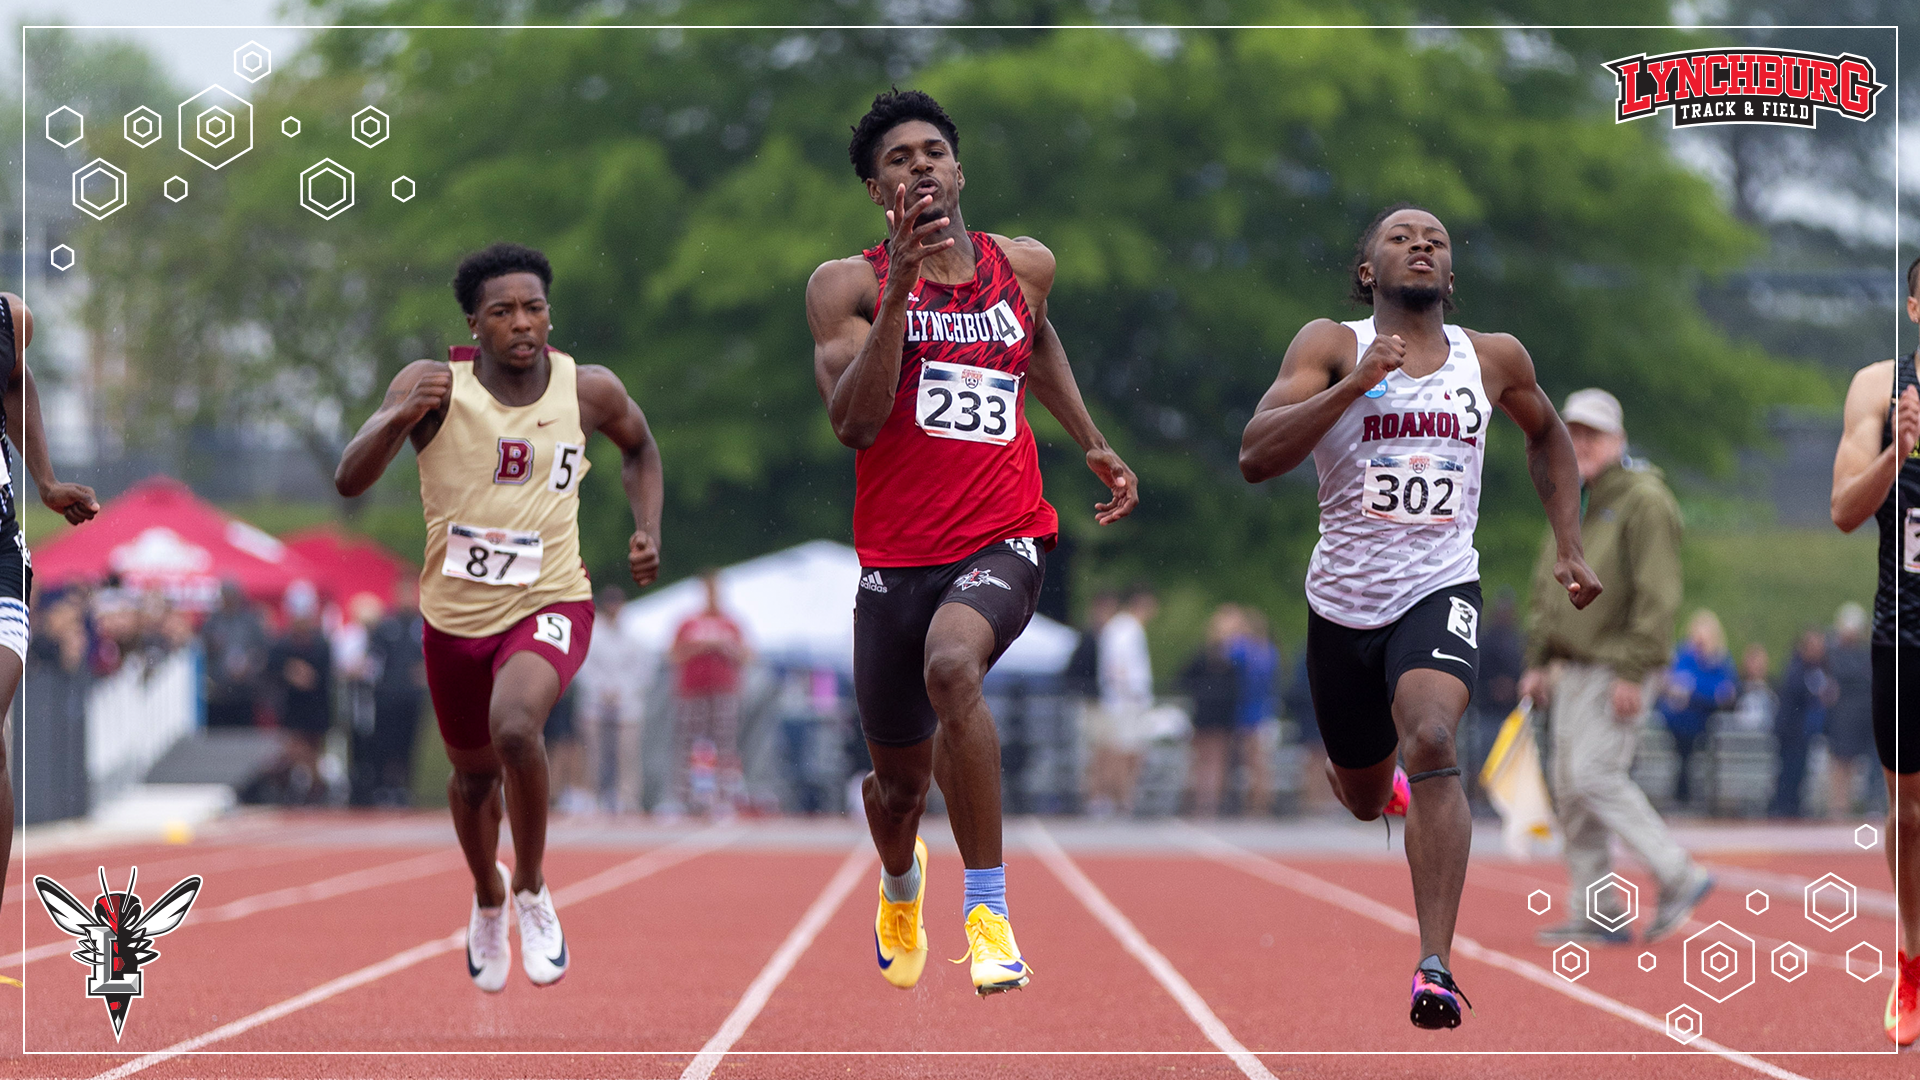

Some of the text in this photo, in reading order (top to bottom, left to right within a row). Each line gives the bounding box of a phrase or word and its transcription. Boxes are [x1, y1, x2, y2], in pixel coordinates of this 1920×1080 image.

[994, 307, 1017, 340] 4
[924, 387, 1007, 436] 233
[1456, 387, 1482, 434] 3
[493, 437, 534, 485] B
[555, 448, 578, 490] 5
[1371, 474, 1454, 516] 302
[466, 546, 518, 581] 87
[860, 580, 888, 593] adidas
[547, 616, 563, 641] 5
[1455, 603, 1473, 639] 3
